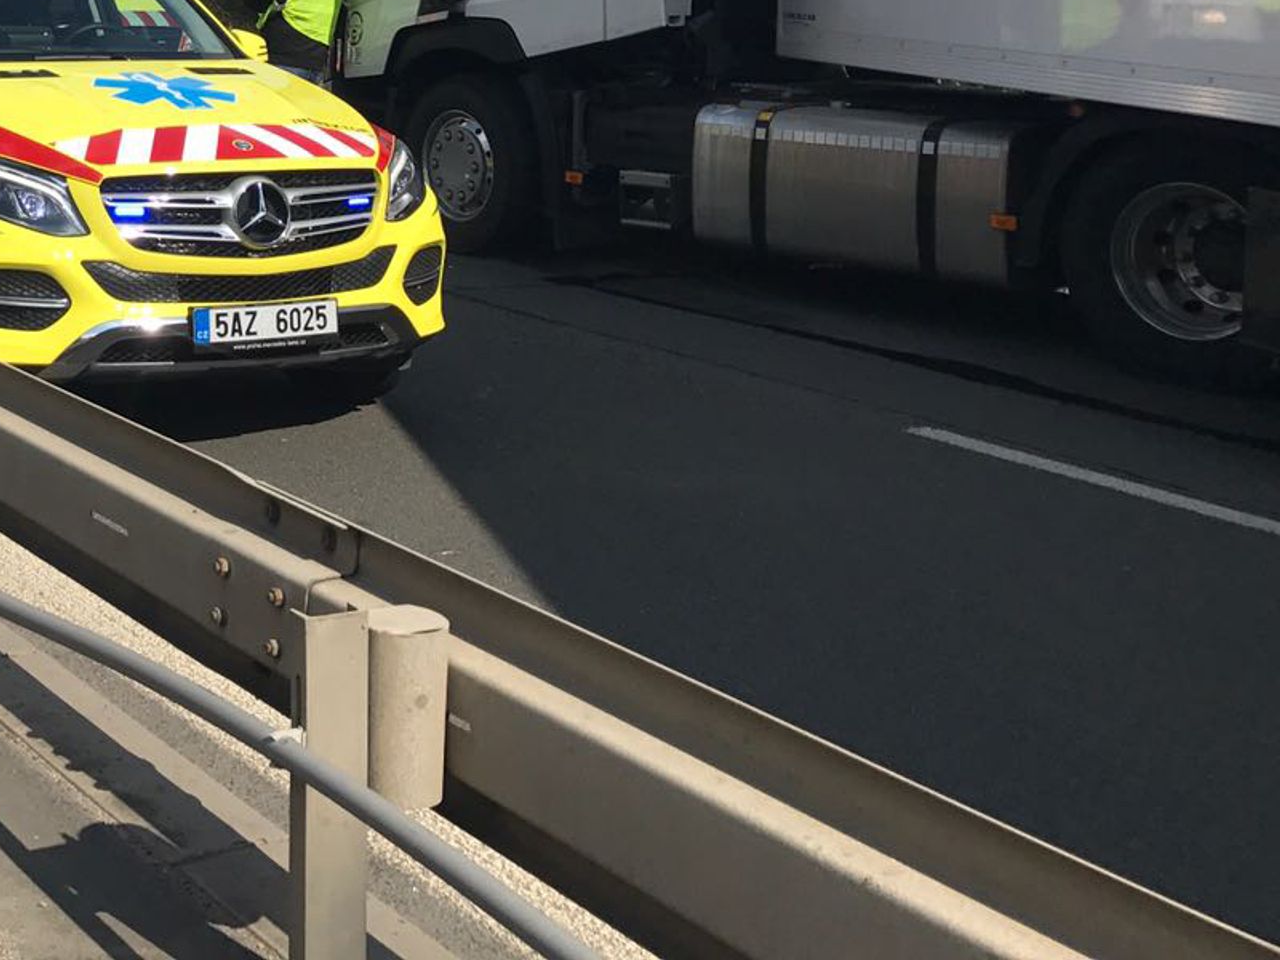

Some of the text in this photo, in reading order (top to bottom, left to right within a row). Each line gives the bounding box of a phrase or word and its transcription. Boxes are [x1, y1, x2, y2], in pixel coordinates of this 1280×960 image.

[215, 305, 328, 338] 5AZ 6025
[196, 331, 209, 339] CZ
